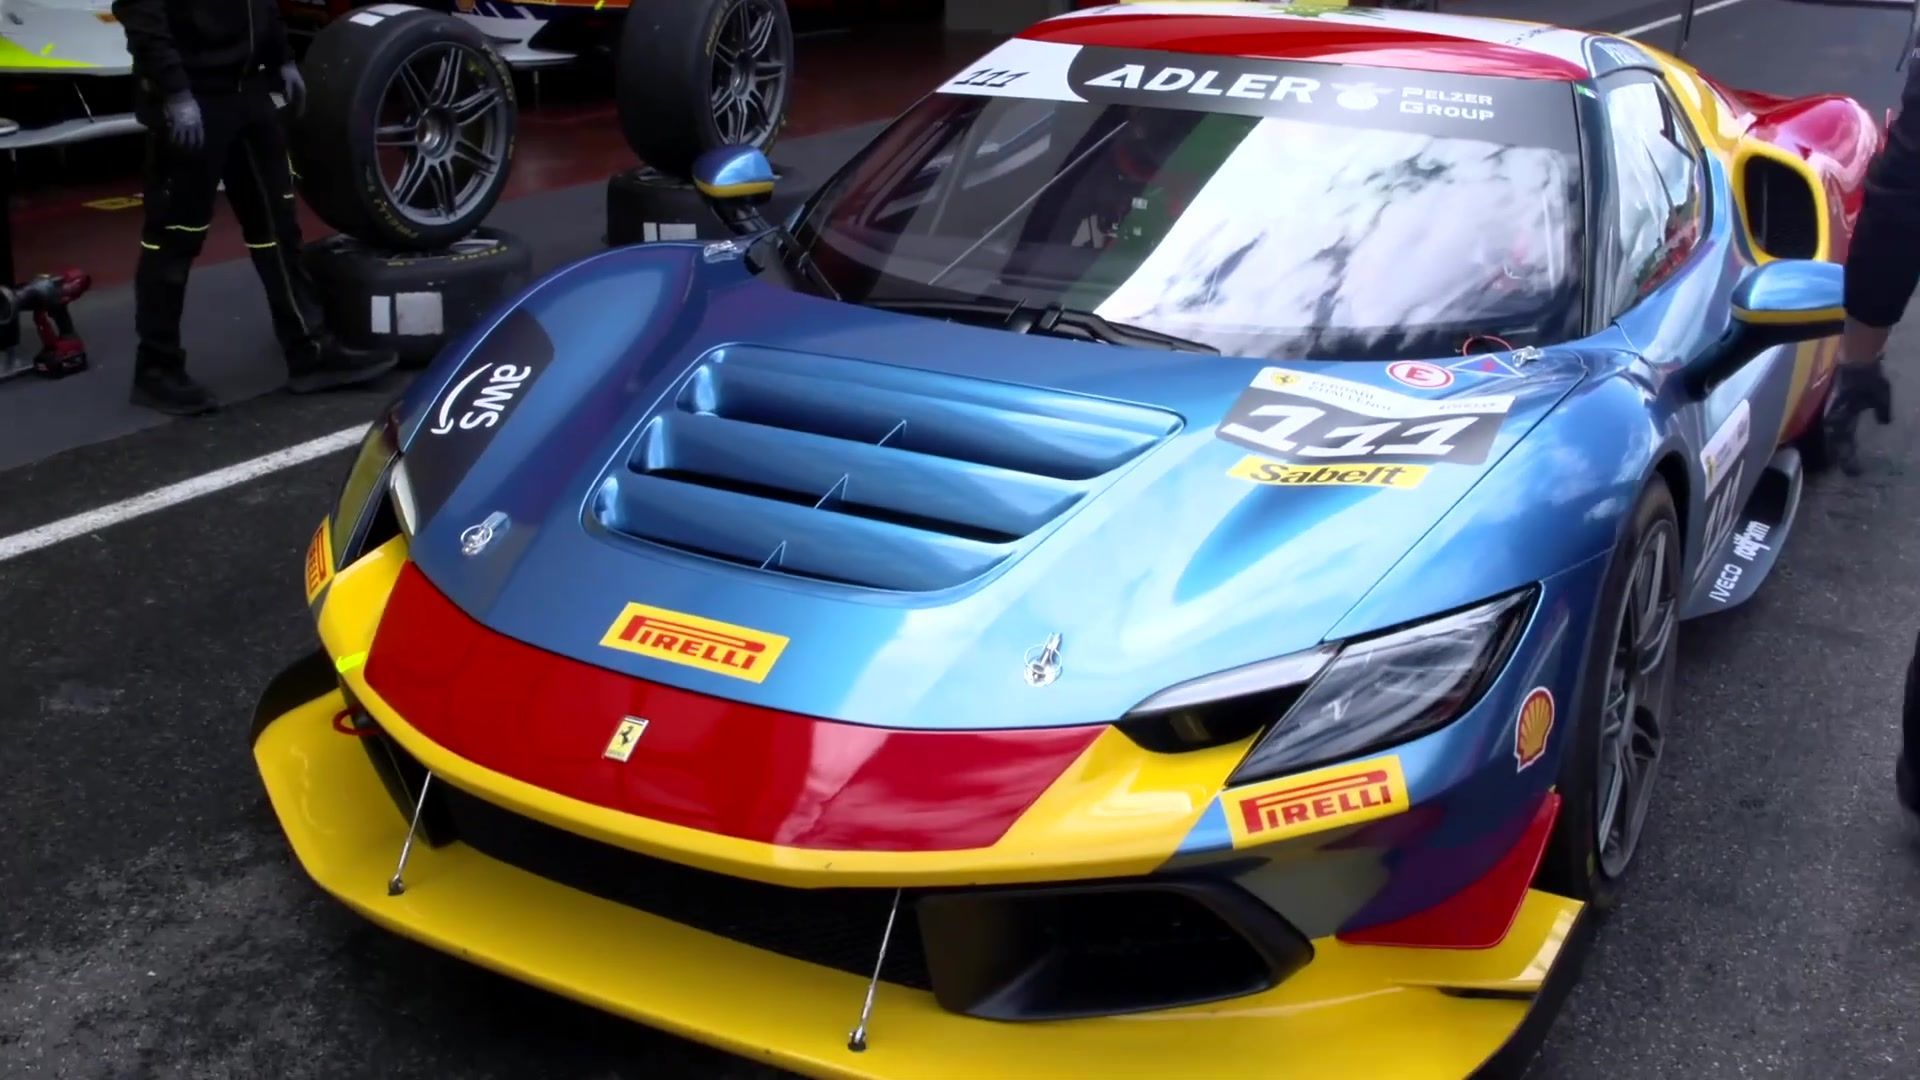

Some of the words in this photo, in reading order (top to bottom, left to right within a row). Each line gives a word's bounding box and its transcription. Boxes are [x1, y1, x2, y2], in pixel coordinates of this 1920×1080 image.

[953, 68, 1030, 88] 111
[1084, 64, 1321, 104] ADLER
[1402, 87, 1493, 105] PELZER
[1400, 101, 1495, 120] GROUP
[1405, 366, 1431, 382] E
[460, 364, 531, 429] aws
[1220, 405, 1480, 457] 111
[1250, 464, 1405, 485] Sabelt
[1709, 564, 1742, 603] IVECO
[618, 615, 766, 670] PIRELLI
[1239, 770, 1392, 834] PIRELLI
